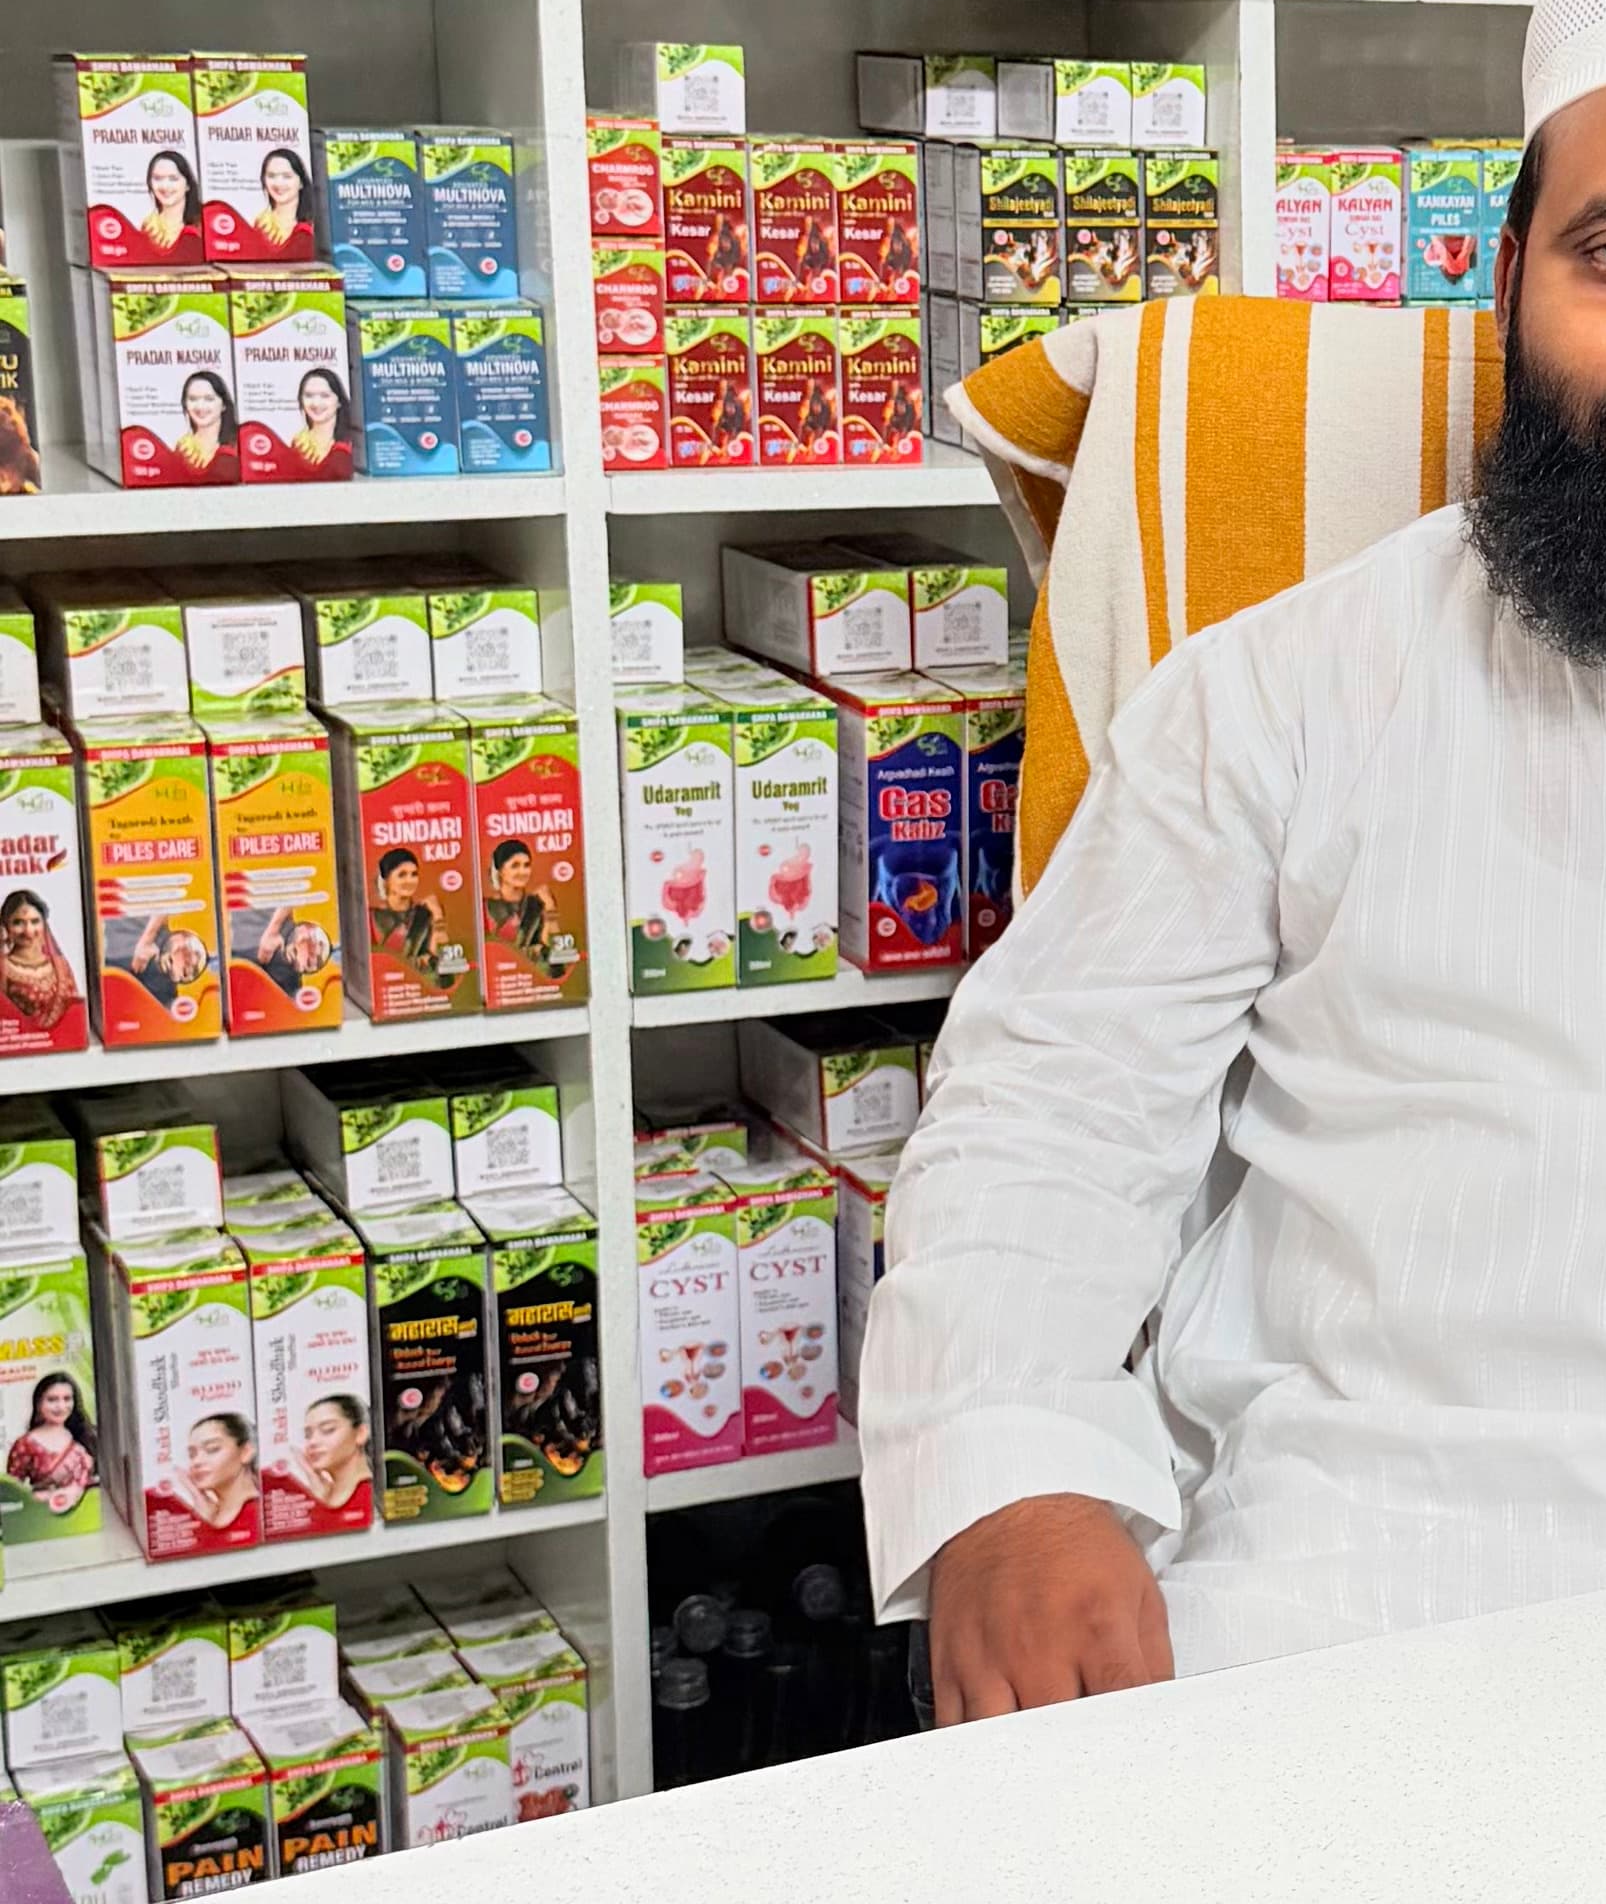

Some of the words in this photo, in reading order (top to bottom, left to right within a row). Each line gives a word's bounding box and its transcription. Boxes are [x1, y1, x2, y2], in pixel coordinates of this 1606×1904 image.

[92, 127, 136, 145] PRADAR
[141, 127, 185, 145] NASHAK
[338, 182, 412, 201] MULTINOVA
[669, 189, 742, 209] Kamini
[671, 222, 712, 238] Kesar
[643, 781, 722, 806] Udaramrit
[880, 785, 951, 821] Gas
[373, 820, 463, 845] SUNDARI
[112, 841, 155, 861] PILES
[157, 839, 197, 858] CARE
[424, 842, 461, 862] KALP
[649, 1271, 730, 1299] CYST
[283, 1820, 378, 1862] PAIN
[295, 1845, 367, 1874] REMEDY
